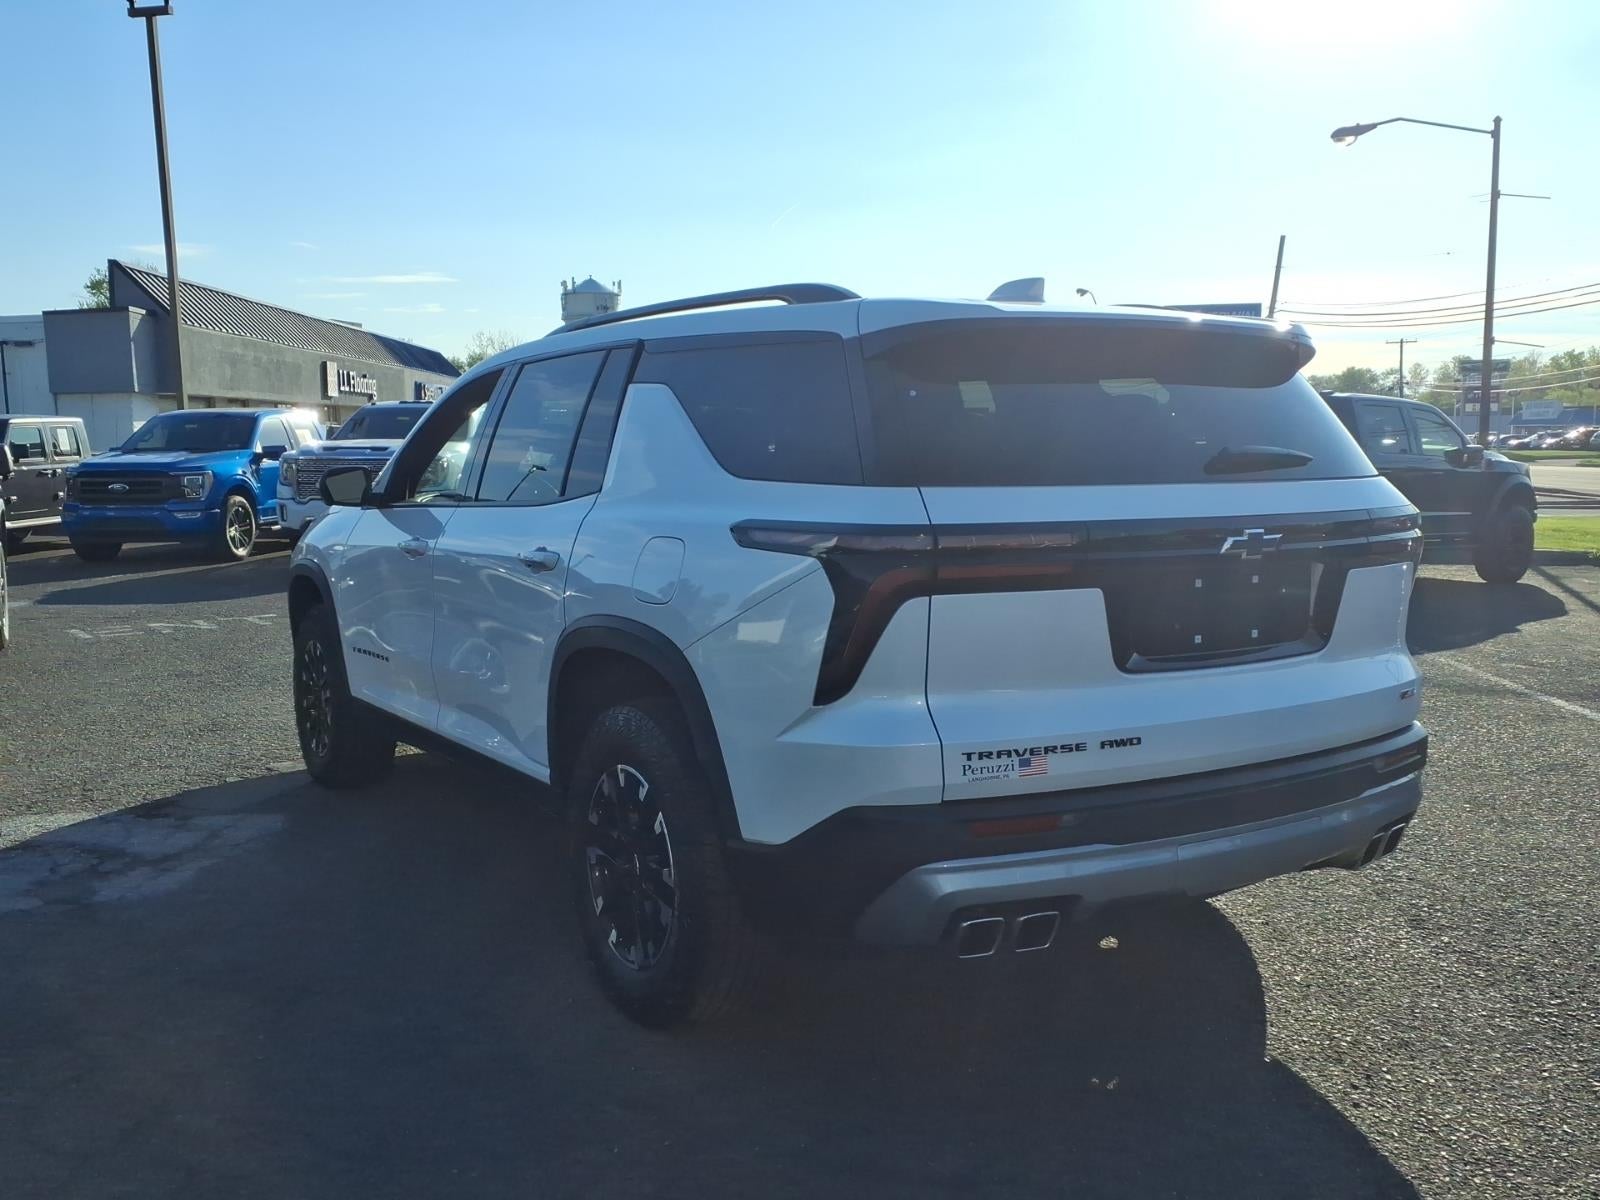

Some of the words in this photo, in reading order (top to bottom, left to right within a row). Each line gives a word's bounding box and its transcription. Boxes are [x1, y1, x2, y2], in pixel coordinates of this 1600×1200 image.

[338, 369, 350, 391] LL
[349, 370, 377, 400] Flooring
[961, 742, 1088, 761] TRAVERSE
[1100, 736, 1142, 750] AWD
[961, 759, 1015, 776] Peruzzi
